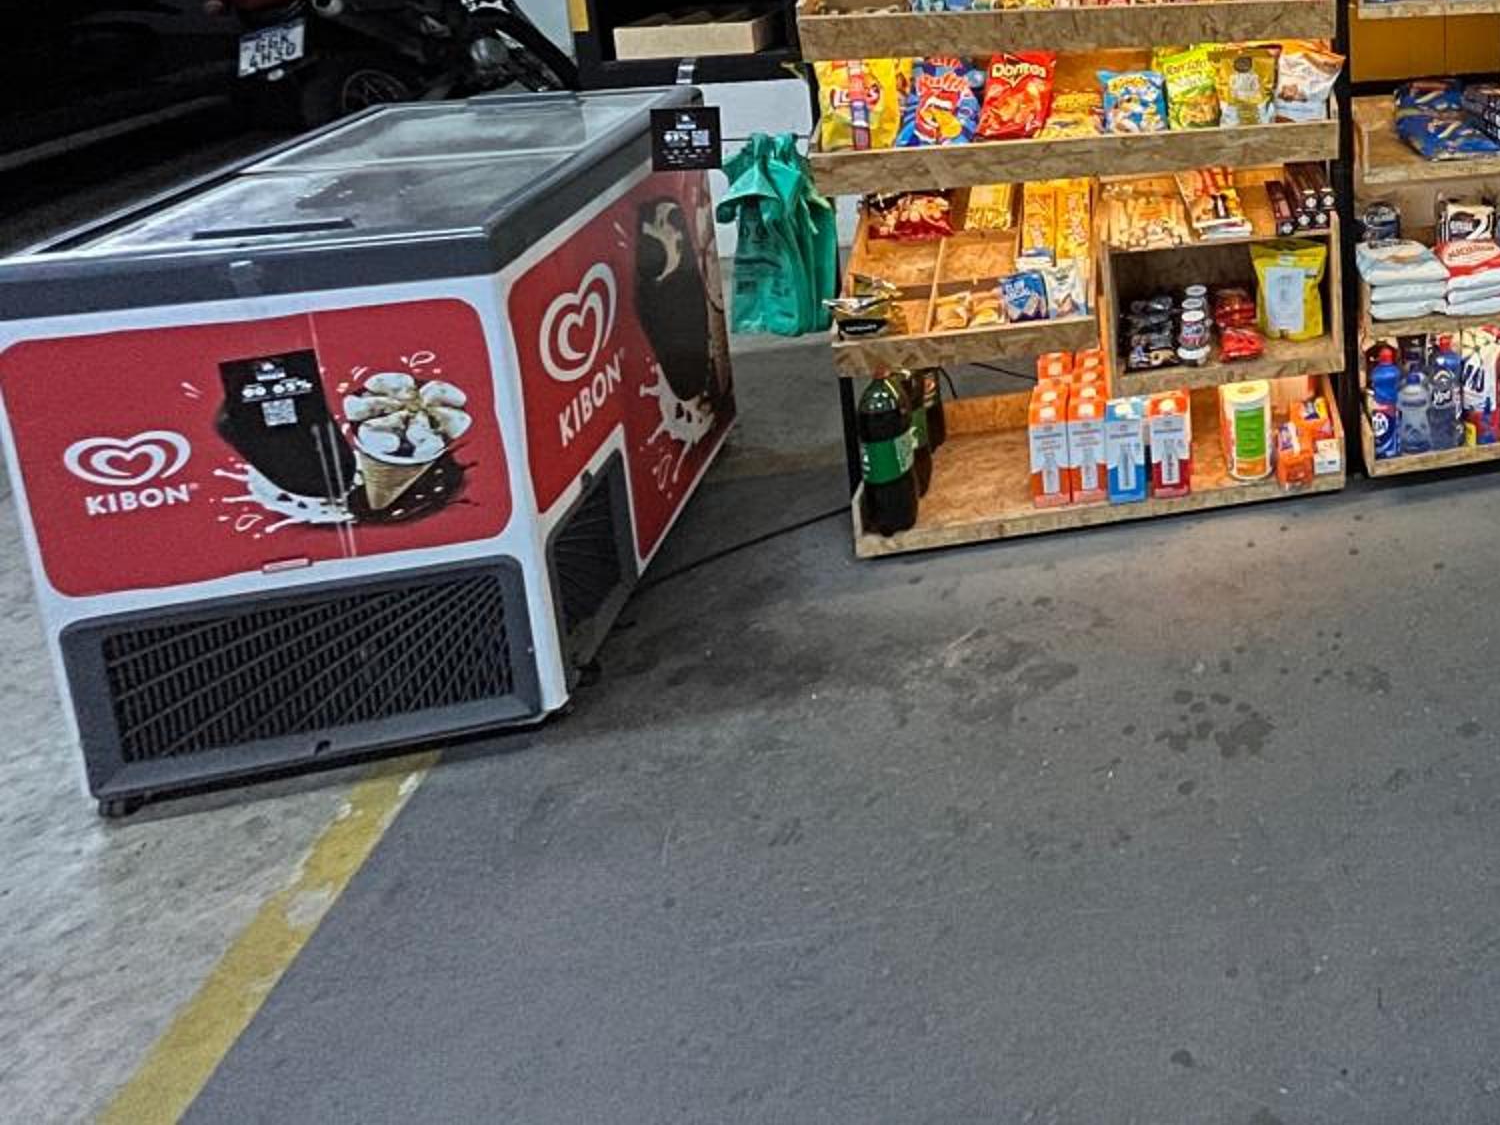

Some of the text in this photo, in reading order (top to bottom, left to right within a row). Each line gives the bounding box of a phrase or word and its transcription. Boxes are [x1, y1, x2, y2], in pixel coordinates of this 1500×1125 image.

[992, 61, 1047, 78] Doritos
[558, 357, 622, 448] KIBON
[85, 483, 191, 516] KIBON
